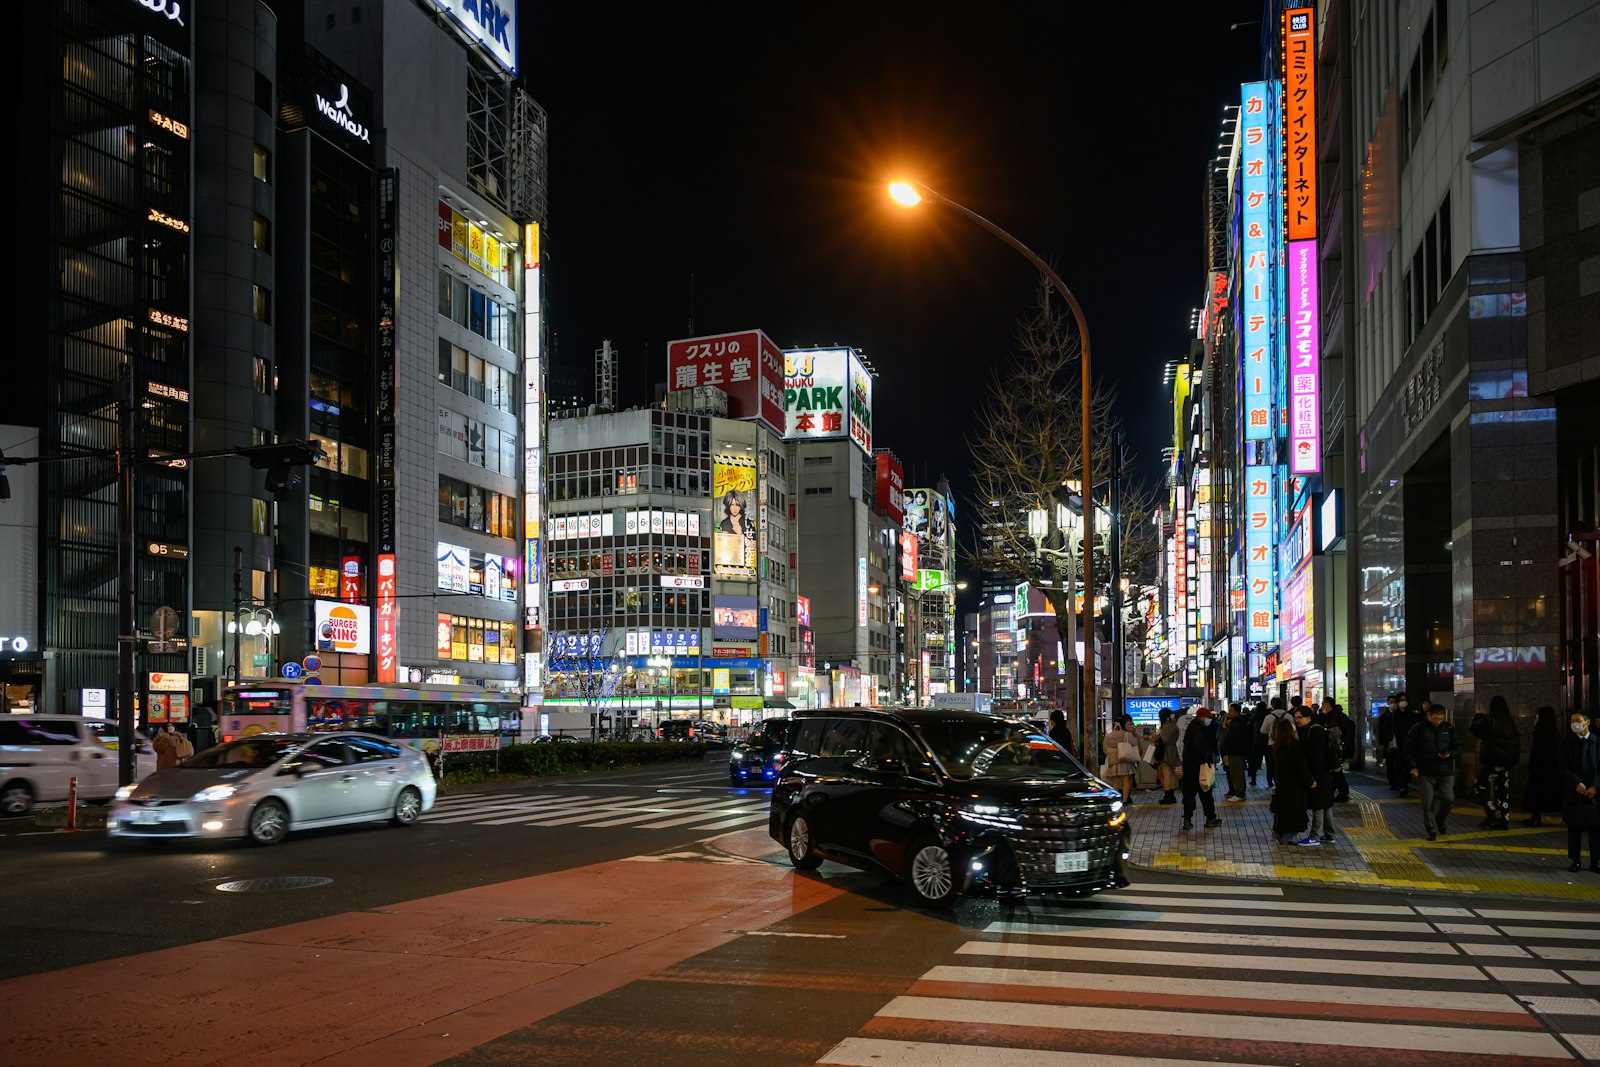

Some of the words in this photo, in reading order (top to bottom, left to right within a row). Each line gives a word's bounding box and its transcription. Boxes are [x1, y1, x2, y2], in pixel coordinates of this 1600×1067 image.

[1292, 16, 1307, 24] 快活
[1293, 40, 1310, 225] コミック・インターネット
[1246, 97, 1268, 426] カラオケ&パーティー館
[686, 341, 740, 360] クスリの
[1295, 310, 1312, 368] コスモス
[676, 358, 751, 388] 龍生堂
[1297, 376, 1312, 391] 薬
[785, 412, 842, 432] 本館
[1298, 397, 1312, 435] 化粧品
[1251, 479, 1269, 628] カラオケ館
[328, 618, 358, 630] BURGER
[331, 629, 358, 641] KING
[381, 579, 394, 670] バーガーキング
